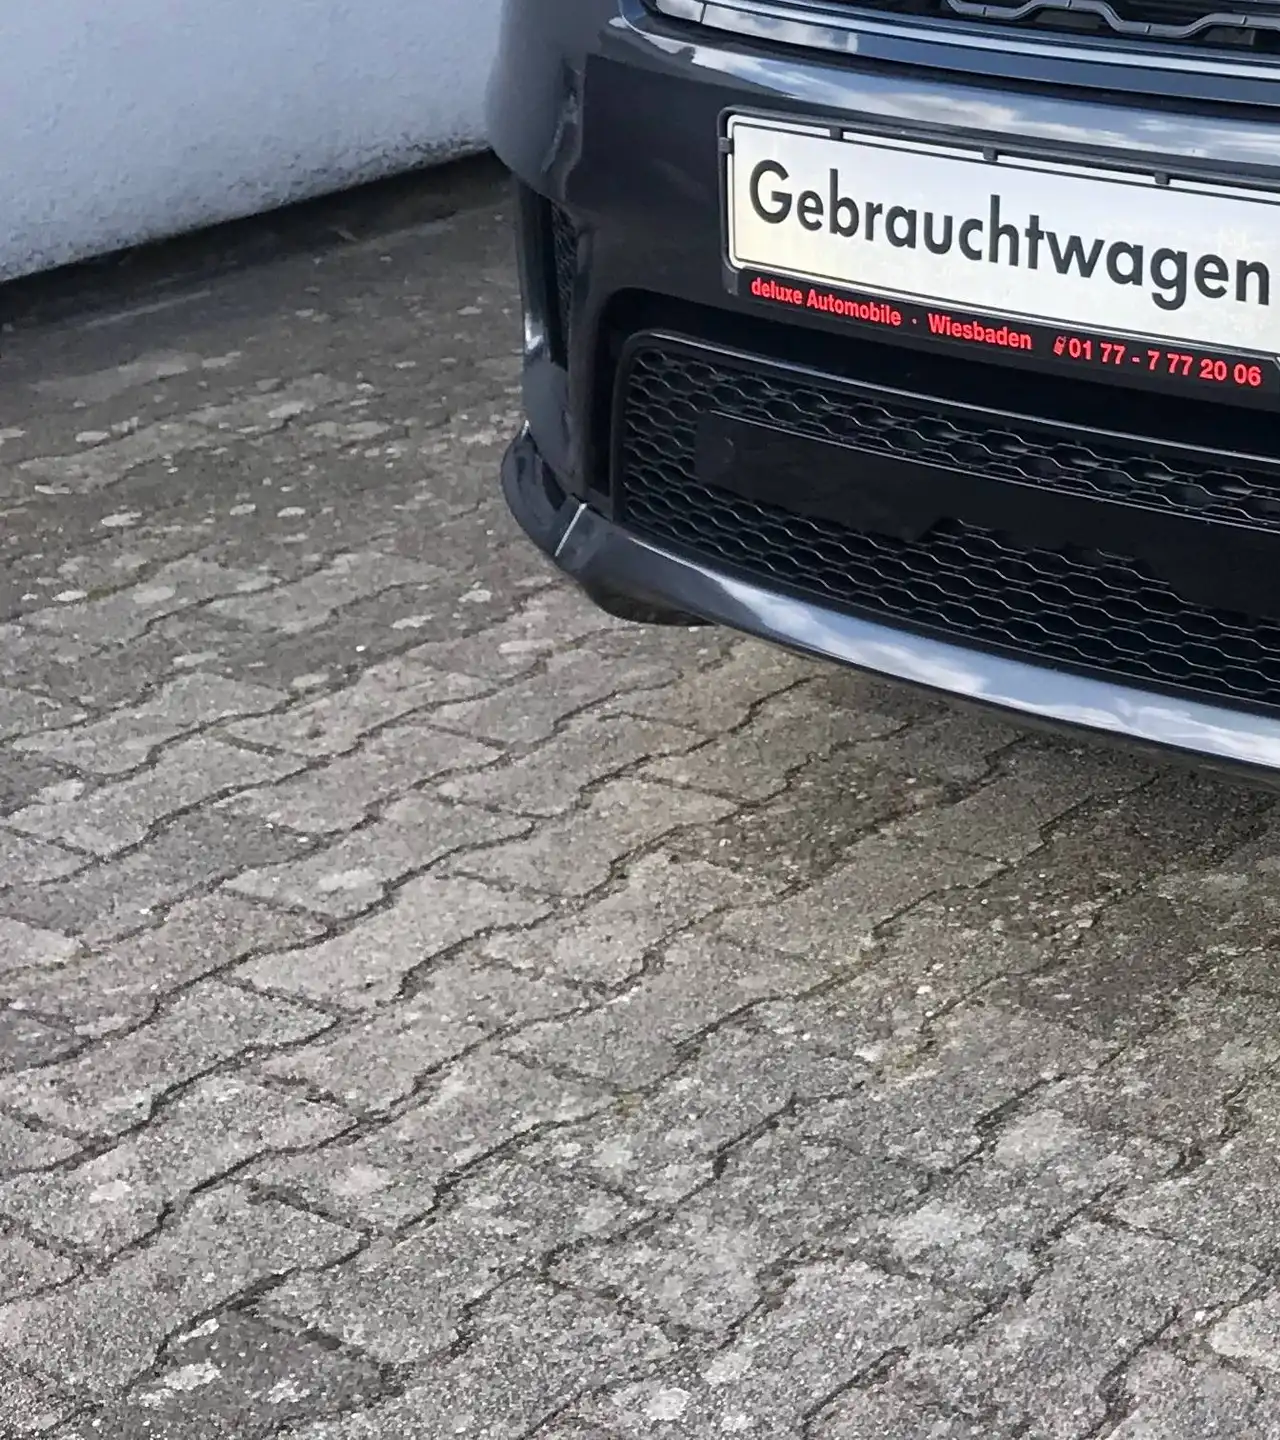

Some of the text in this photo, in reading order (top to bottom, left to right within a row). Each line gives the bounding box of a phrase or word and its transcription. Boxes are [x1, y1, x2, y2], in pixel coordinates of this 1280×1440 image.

[748, 159, 1270, 311] Gebrauchtwagen
[751, 277, 803, 305] deluxe
[806, 288, 901, 326] Automobile
[927, 313, 1032, 350] Wiesbaden
[1100, 342, 1126, 365] 77
[1147, 350, 1160, 371] 7
[1166, 353, 1193, 376] 77
[1199, 359, 1227, 381] 20
[1233, 363, 1262, 387] 06
